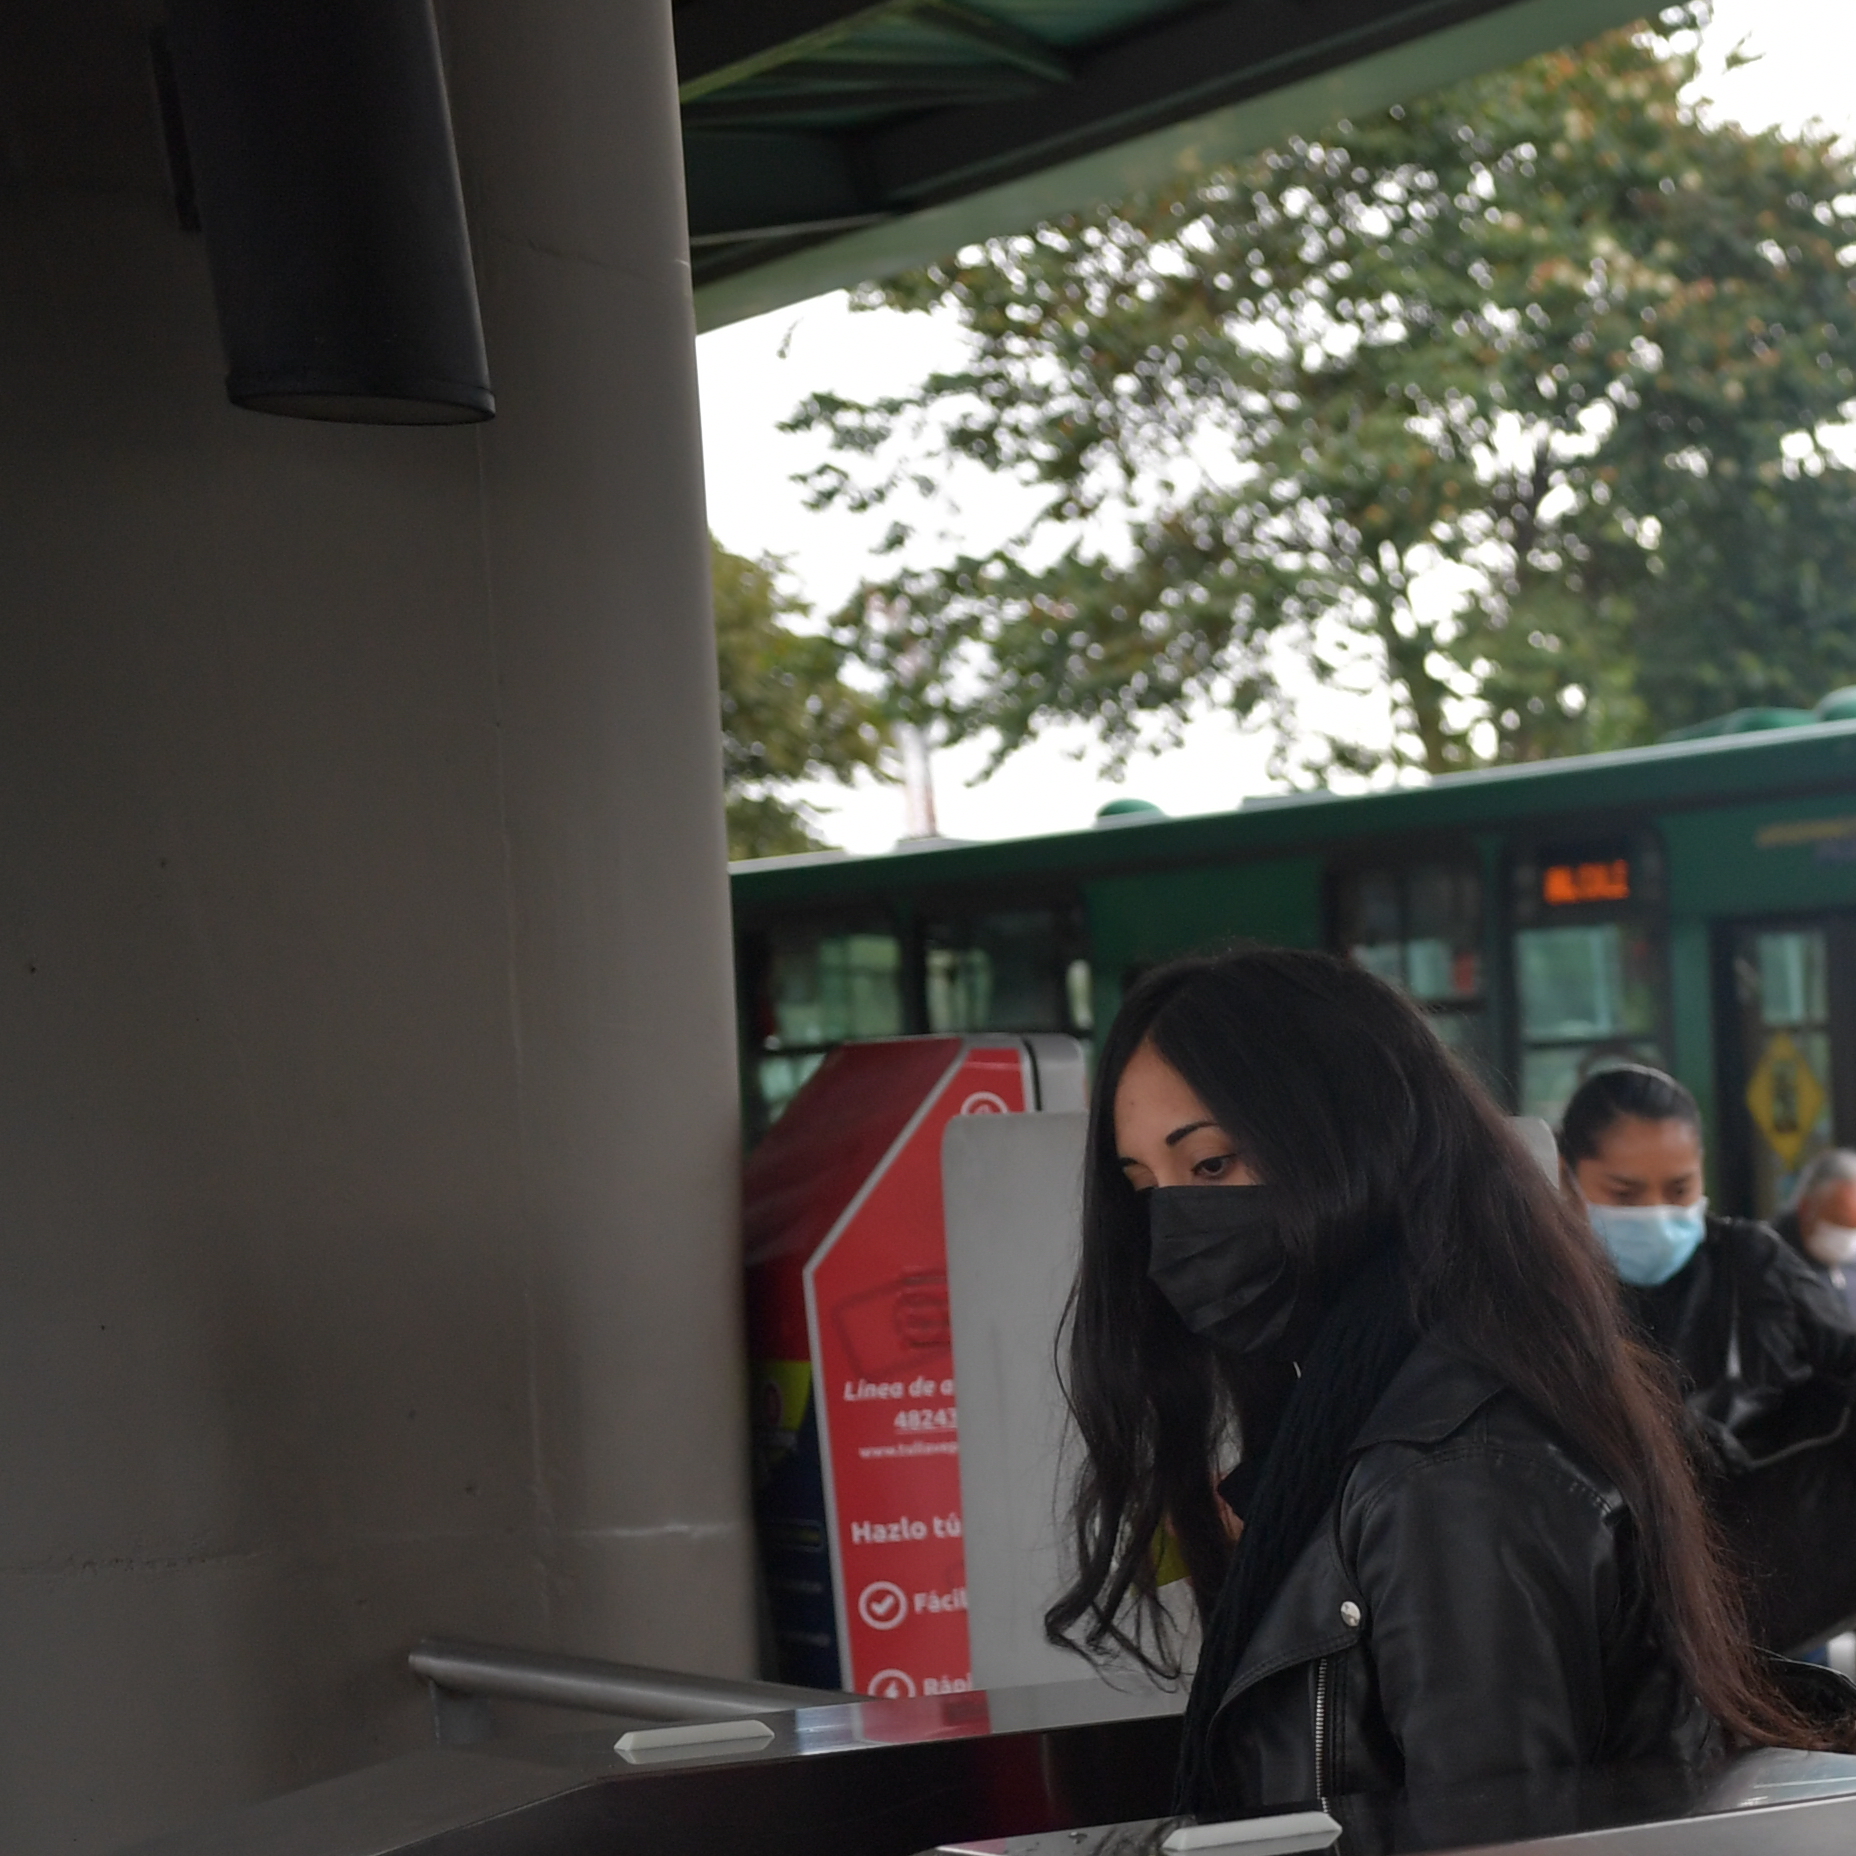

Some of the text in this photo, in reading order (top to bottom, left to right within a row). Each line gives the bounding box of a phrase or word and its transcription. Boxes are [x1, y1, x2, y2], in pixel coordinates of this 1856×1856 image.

[908, 1375, 936, 1398] de
[851, 1511, 963, 1545] Hazlo tú
